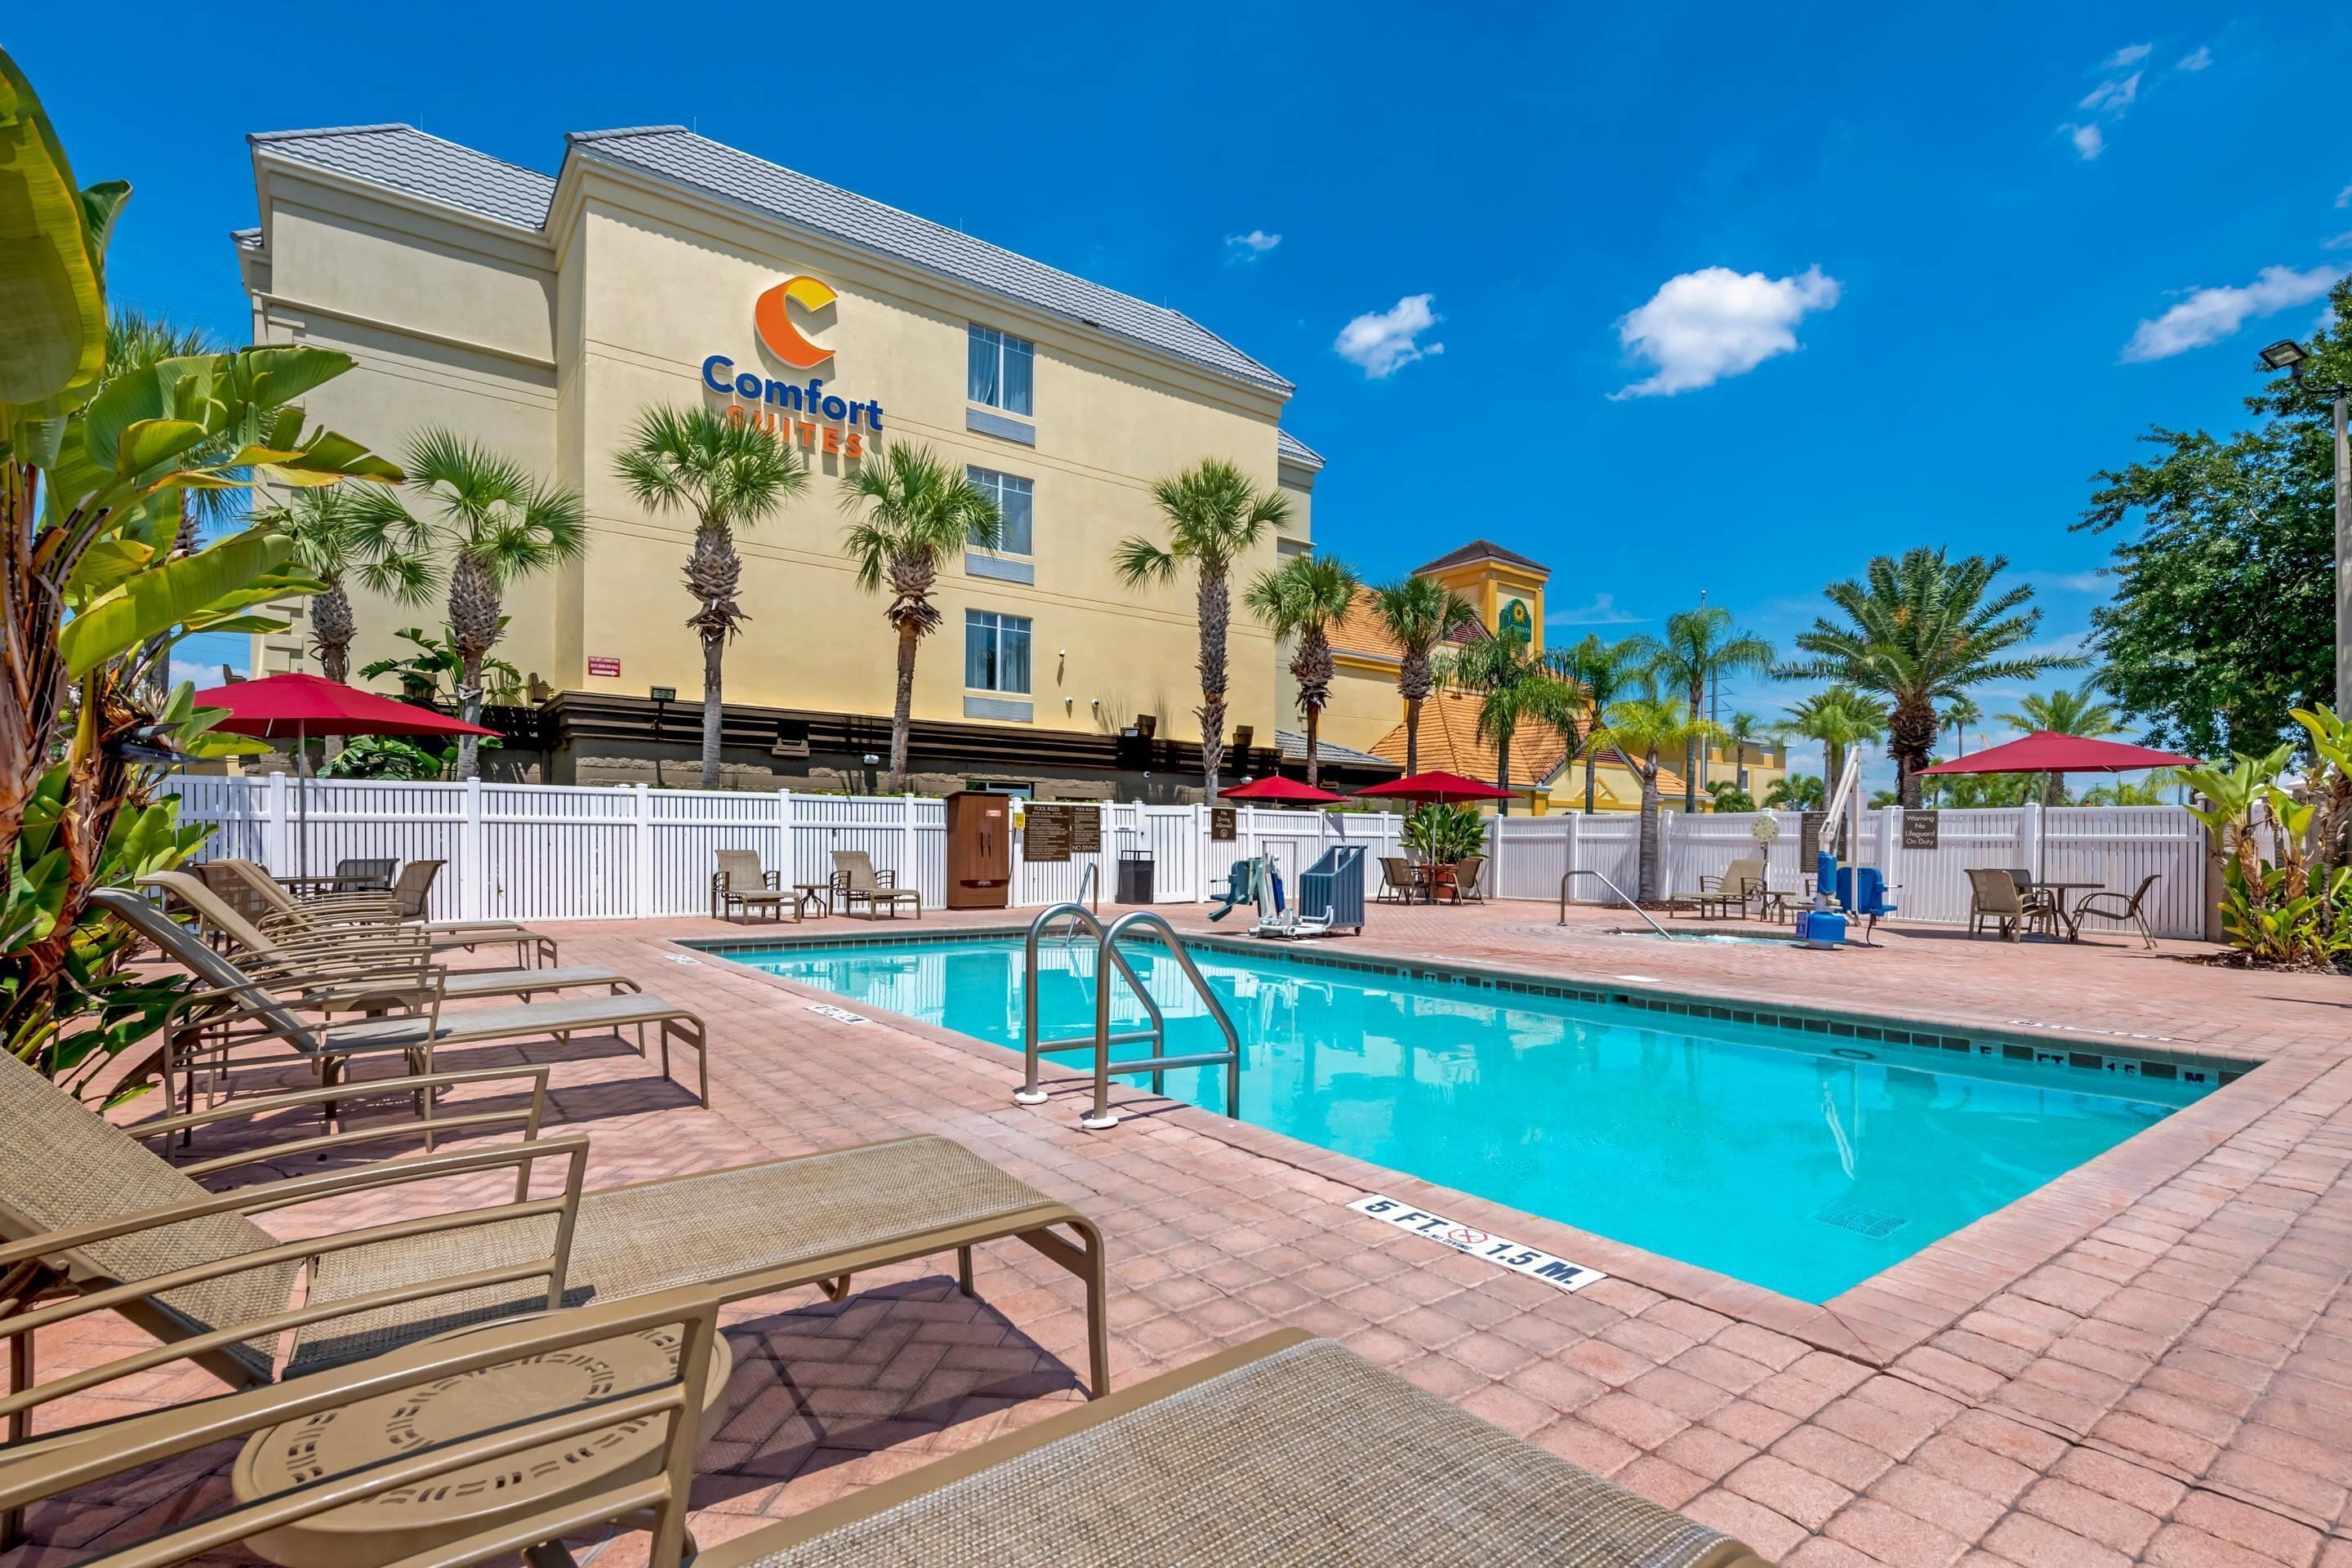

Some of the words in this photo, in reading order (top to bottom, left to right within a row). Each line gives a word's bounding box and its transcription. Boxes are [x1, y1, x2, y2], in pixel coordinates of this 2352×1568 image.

[702, 354, 884, 433] Comfort
[726, 404, 862, 458] SUITES
[1905, 830, 1936, 838] Lifeguard
[1918, 838, 1934, 846] Duty
[1365, 1200, 1400, 1213] 5
[1392, 1212, 1450, 1232] FT.
[1486, 1243, 1543, 1265] 1.5
[1533, 1261, 1584, 1285] M.
[1443, 1239, 1473, 1251] DIVING
